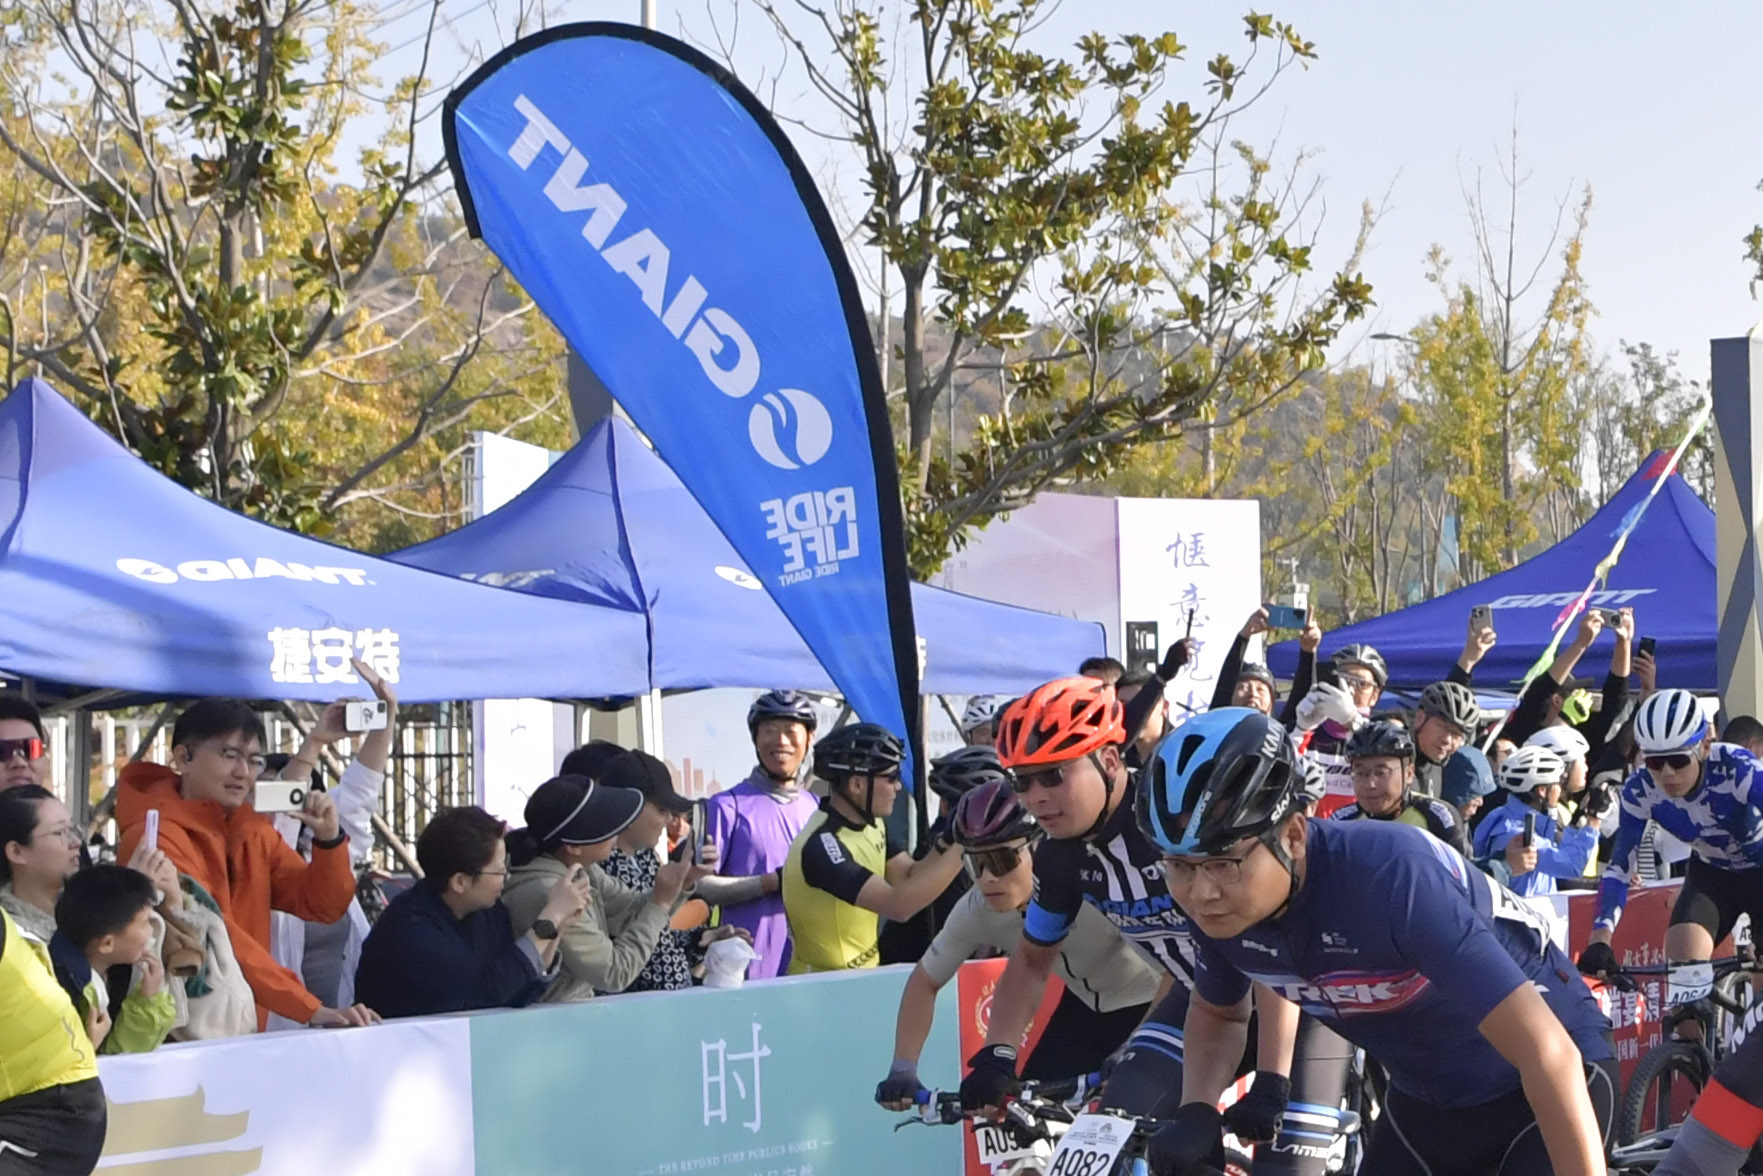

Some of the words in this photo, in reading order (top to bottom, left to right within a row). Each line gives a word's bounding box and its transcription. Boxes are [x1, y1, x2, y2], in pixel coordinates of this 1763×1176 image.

[177, 557, 368, 587] GIANT
[266, 626, 400, 685] 捷安特
